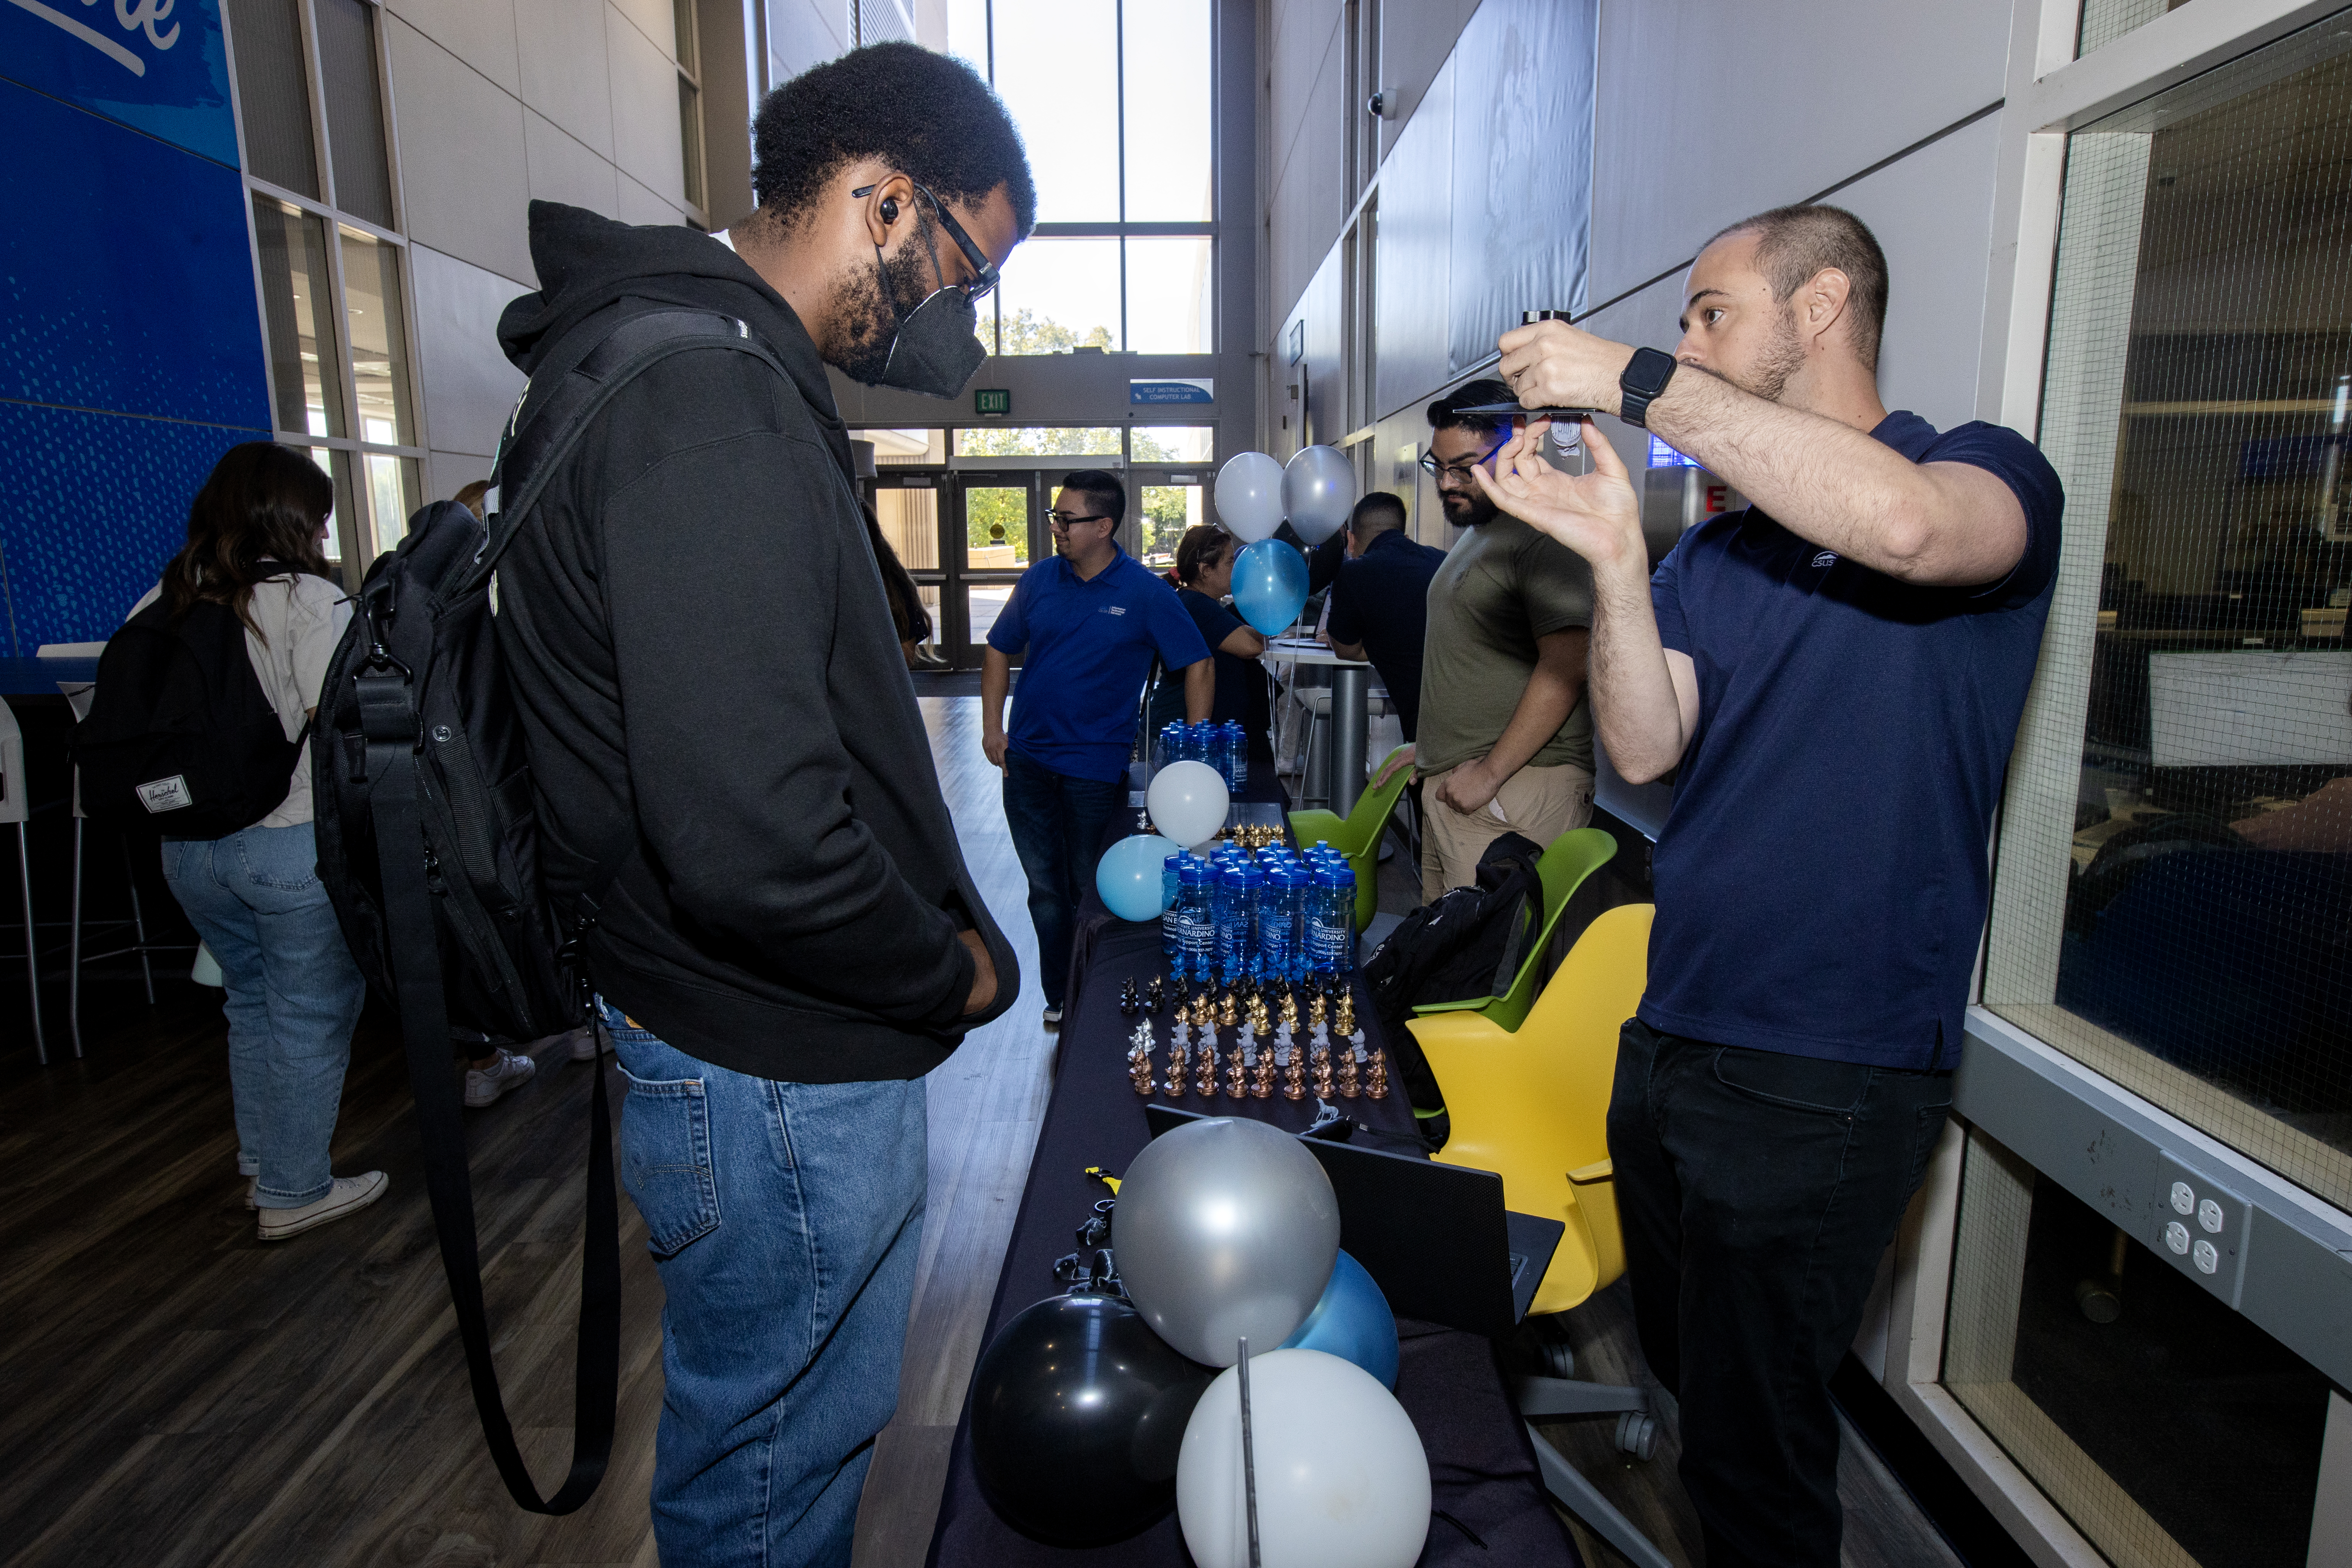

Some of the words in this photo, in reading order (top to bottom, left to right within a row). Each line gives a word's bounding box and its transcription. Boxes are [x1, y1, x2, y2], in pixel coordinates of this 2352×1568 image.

[981, 393, 1004, 409] EXIT
[1706, 486, 1727, 512] E
[149, 783, 179, 802] Herschel
[1162, 915, 1173, 923] SAN
[1177, 927, 1215, 937] ERNARDINO
[1311, 929, 1345, 941] RNARDINO
